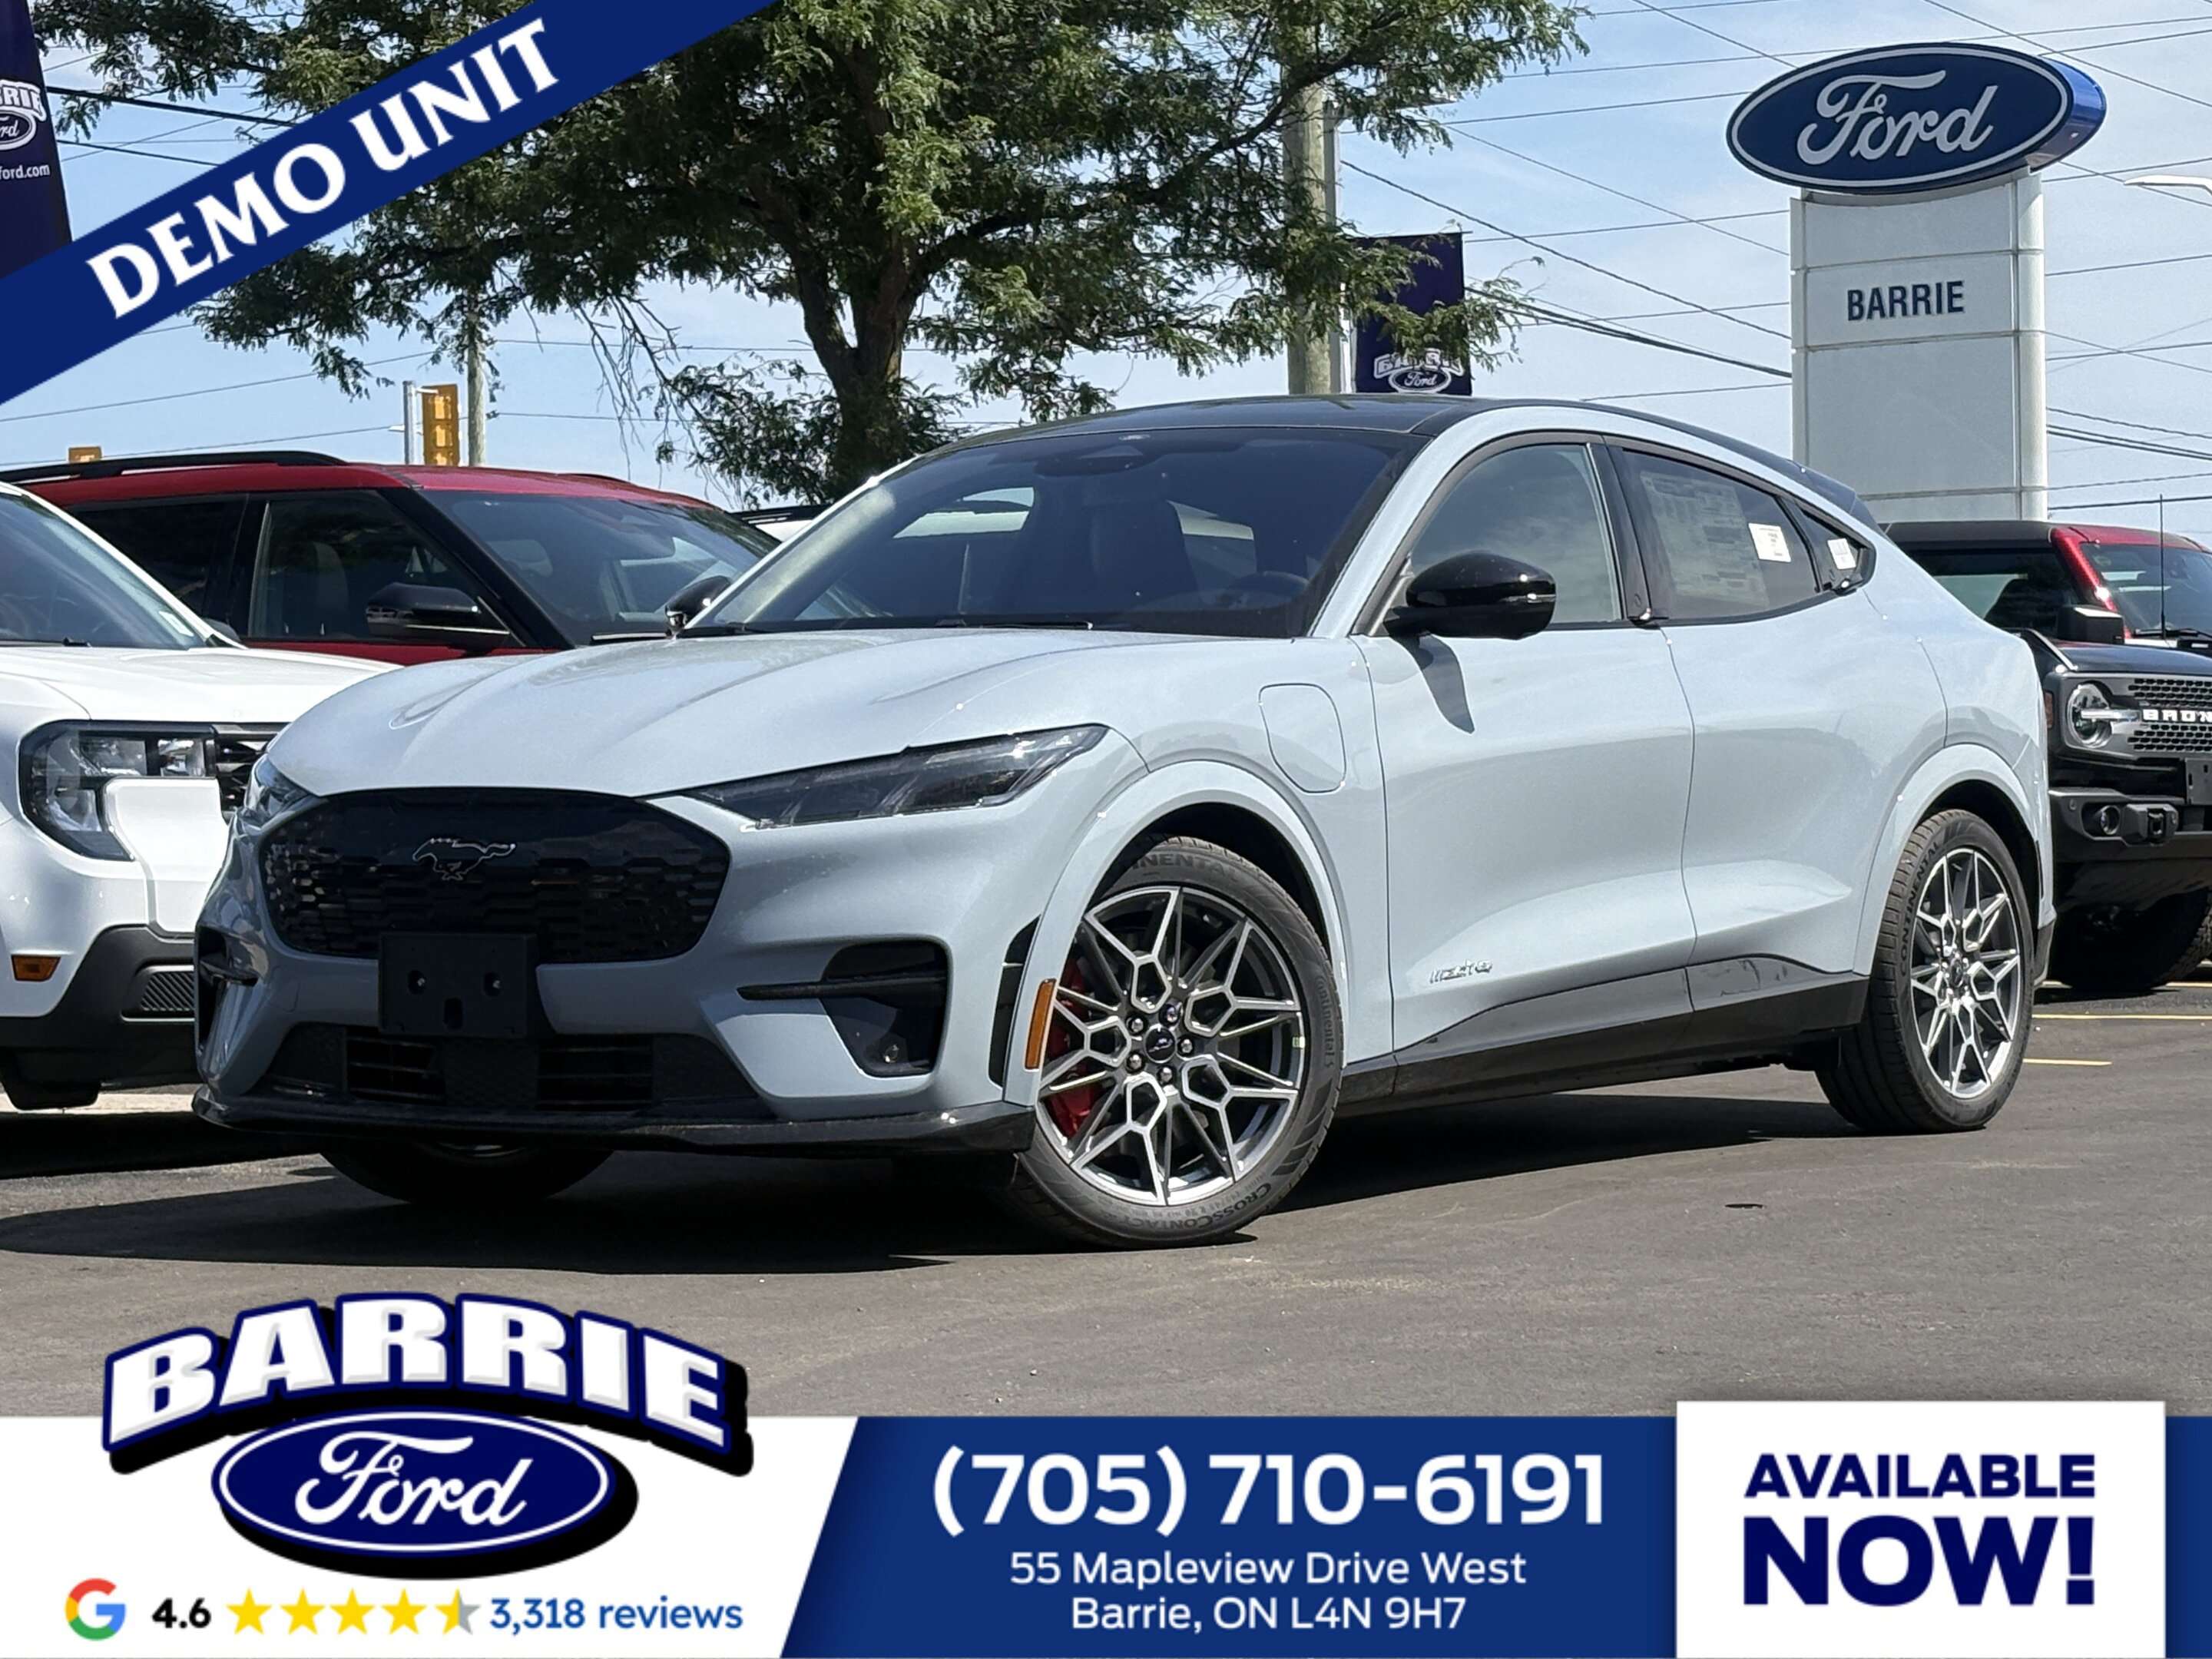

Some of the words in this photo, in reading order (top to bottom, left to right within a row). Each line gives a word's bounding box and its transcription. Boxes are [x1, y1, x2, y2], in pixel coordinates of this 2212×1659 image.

[1796, 70, 1998, 164] Ford
[1847, 280, 1965, 321] BARRIE
[1404, 372, 1438, 386] Ford
